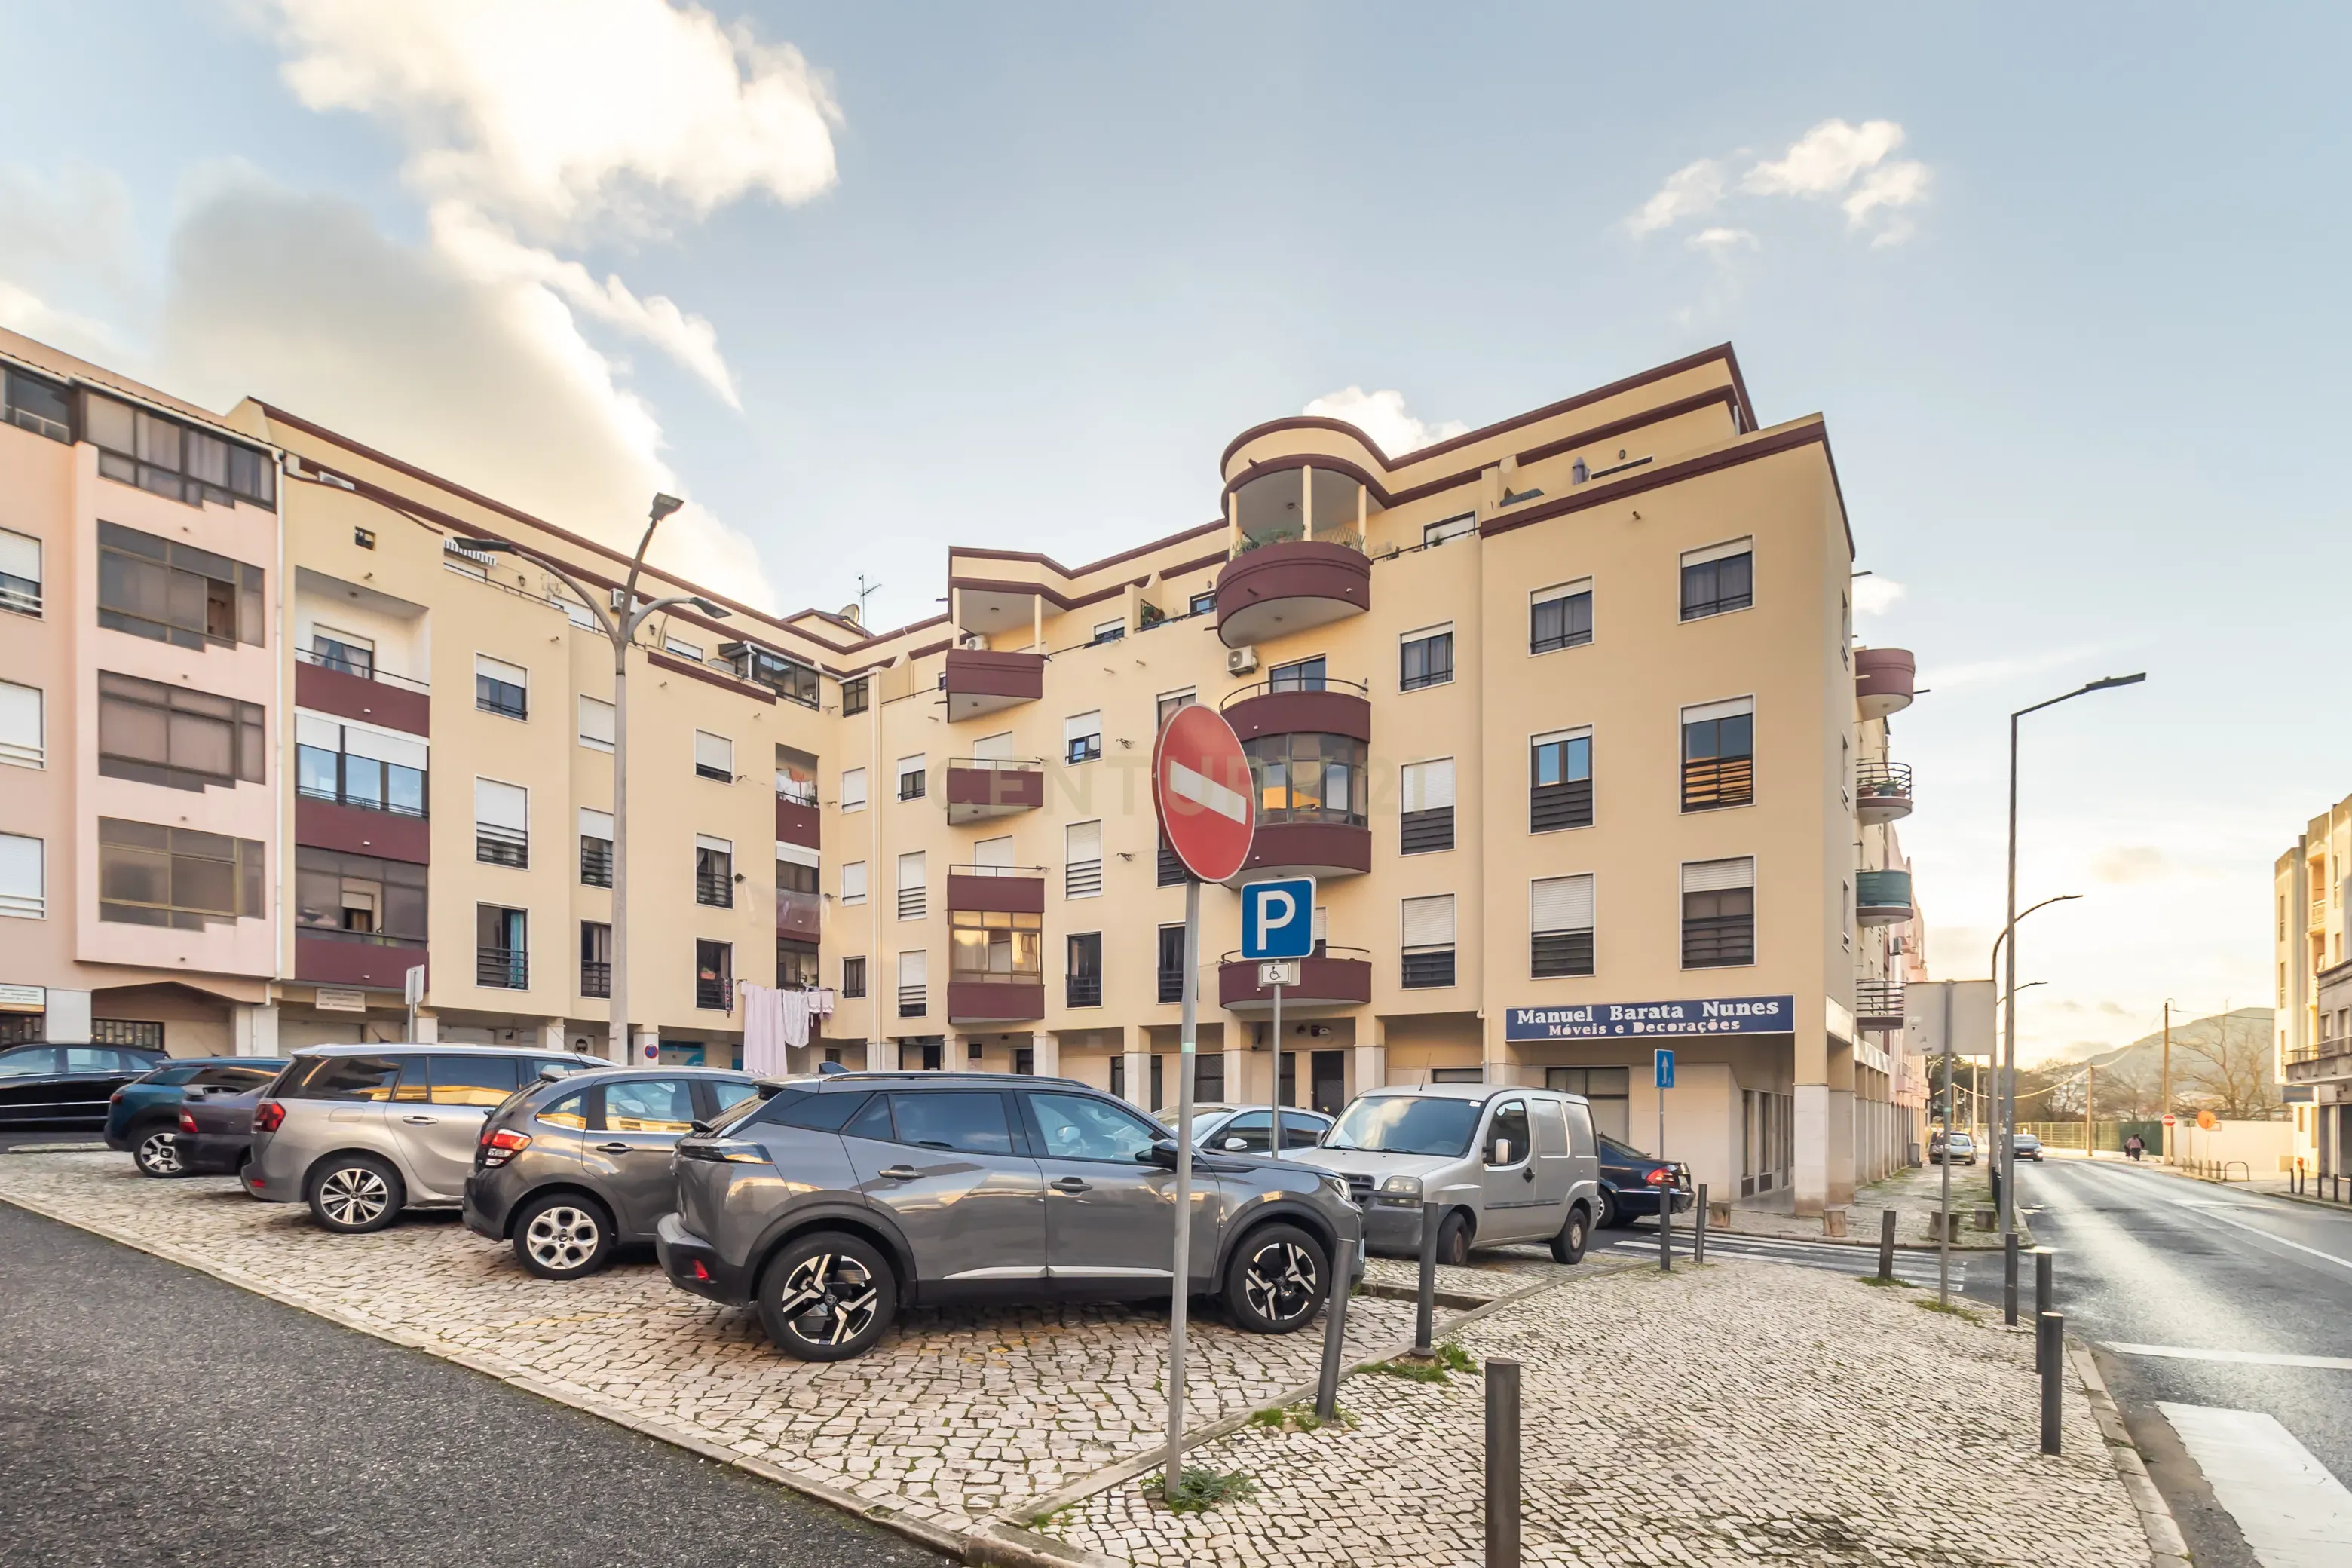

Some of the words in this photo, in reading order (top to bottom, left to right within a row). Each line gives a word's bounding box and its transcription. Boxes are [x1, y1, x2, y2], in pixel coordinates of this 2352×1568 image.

[1257, 890, 1297, 951] P
[1517, 1006, 1594, 1024] Manuel
[1609, 1004, 1685, 1021] Barata
[1701, 1000, 1780, 1018] Nunes
[1548, 1022, 1607, 1036] Móveis
[1614, 1024, 1625, 1034] e
[1632, 1018, 1741, 1034] Decorações
